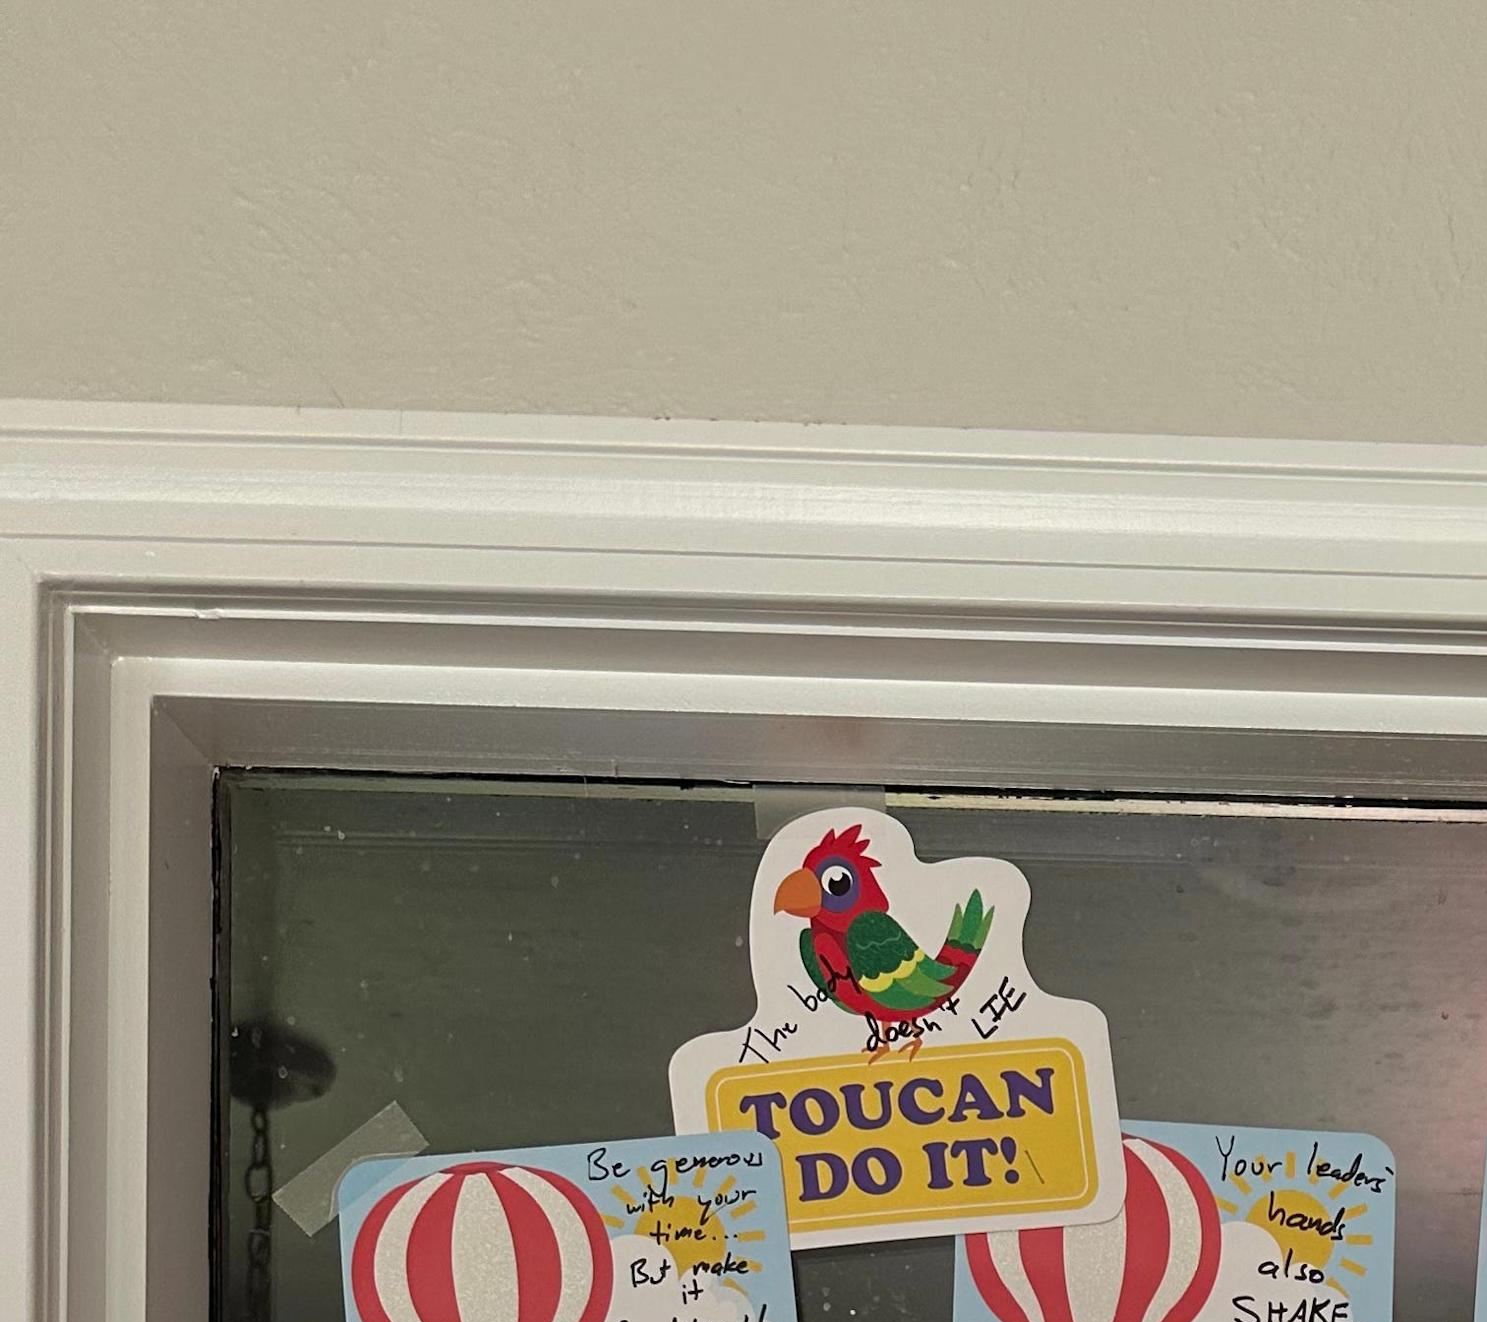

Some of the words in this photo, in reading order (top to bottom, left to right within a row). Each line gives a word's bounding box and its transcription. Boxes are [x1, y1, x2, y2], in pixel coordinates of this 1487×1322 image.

[738, 1023, 799, 1065] The
[787, 953, 863, 1013] body
[864, 995, 961, 1053] doesn't
[970, 975, 1028, 1039] LIE
[739, 1067, 1055, 1141] TOUCAN
[586, 1147, 632, 1181] Be
[797, 1146, 903, 1203] DO
[922, 1136, 1021, 1190] IT!
[1215, 1134, 1283, 1182] Your
[626, 1184, 676, 1217] with
[697, 1187, 757, 1226] your
[1267, 1191, 1347, 1241] hands
[629, 1258, 672, 1288] But
[691, 1251, 750, 1276] make
[1257, 1248, 1326, 1285] also
[681, 1282, 705, 1305] it
